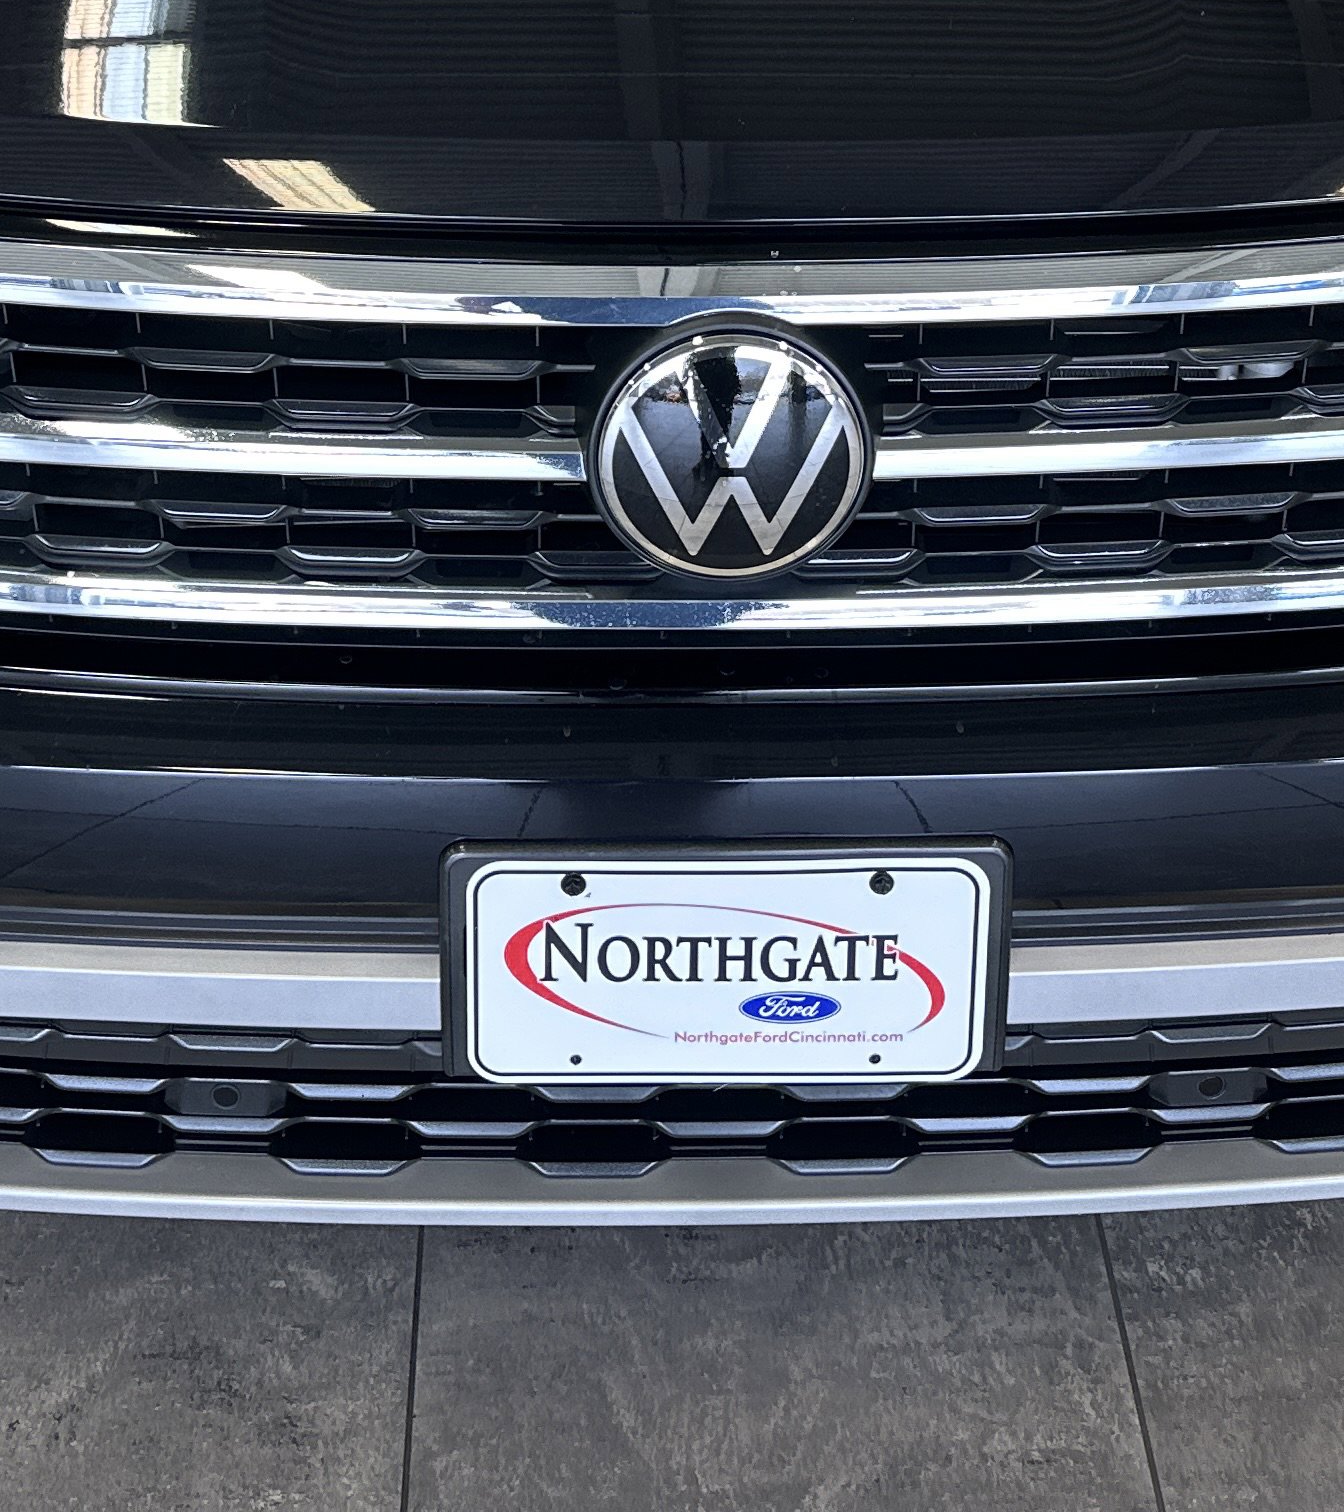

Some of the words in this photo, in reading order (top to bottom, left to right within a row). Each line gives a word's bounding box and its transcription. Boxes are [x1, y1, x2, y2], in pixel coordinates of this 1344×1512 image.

[538, 922, 901, 984] NORTHGATE
[756, 993, 821, 1021] Ford
[673, 1030, 904, 1045] NorthgateFordCincinnati.com
